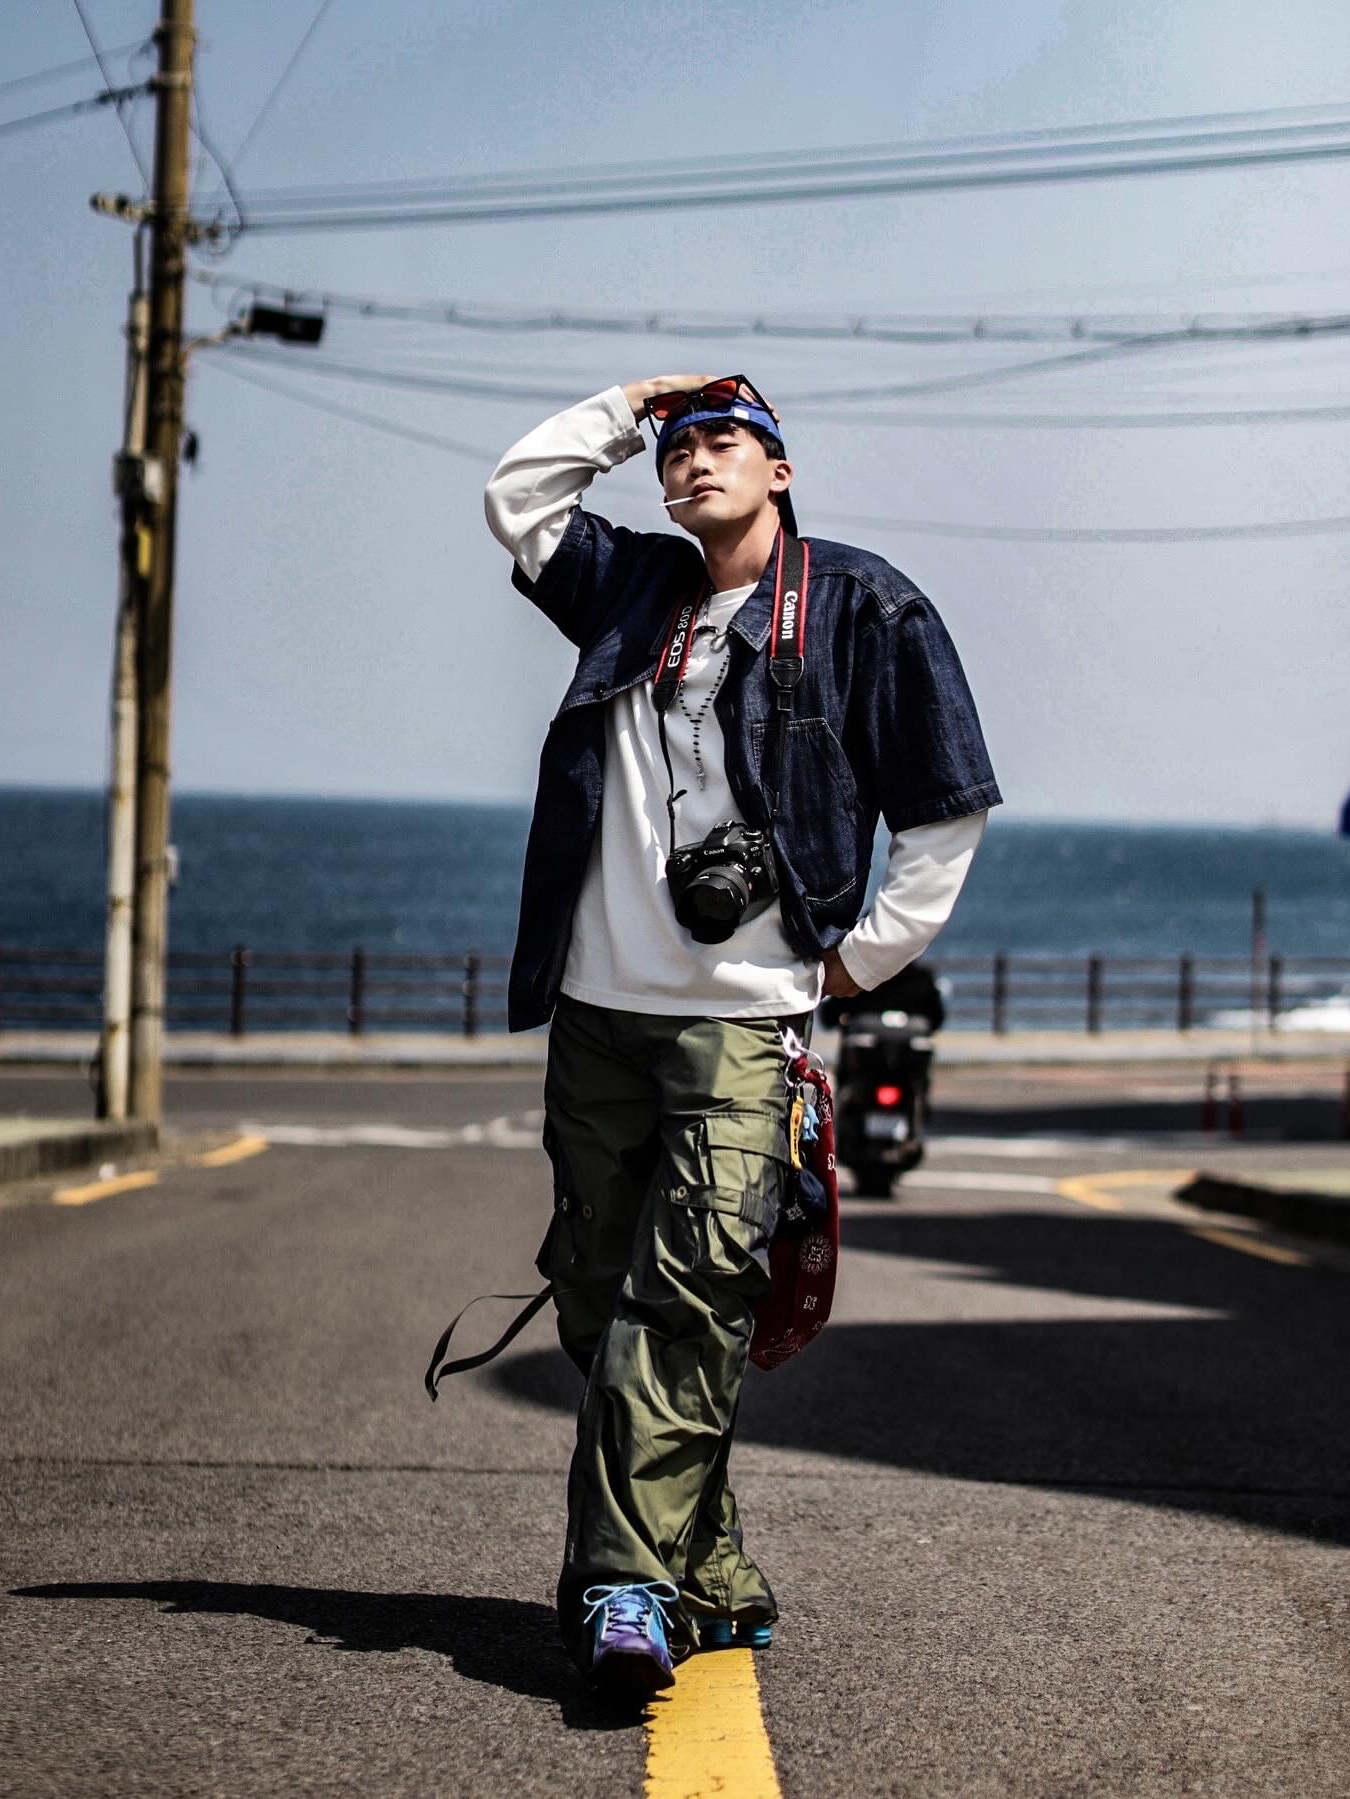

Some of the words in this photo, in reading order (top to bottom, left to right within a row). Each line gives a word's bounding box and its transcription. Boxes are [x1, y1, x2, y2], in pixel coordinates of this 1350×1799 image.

[667, 631, 686, 668] EOS
[678, 605, 693, 630] 80D
[781, 590, 798, 640] Canon
[703, 848, 725, 856] Canon
